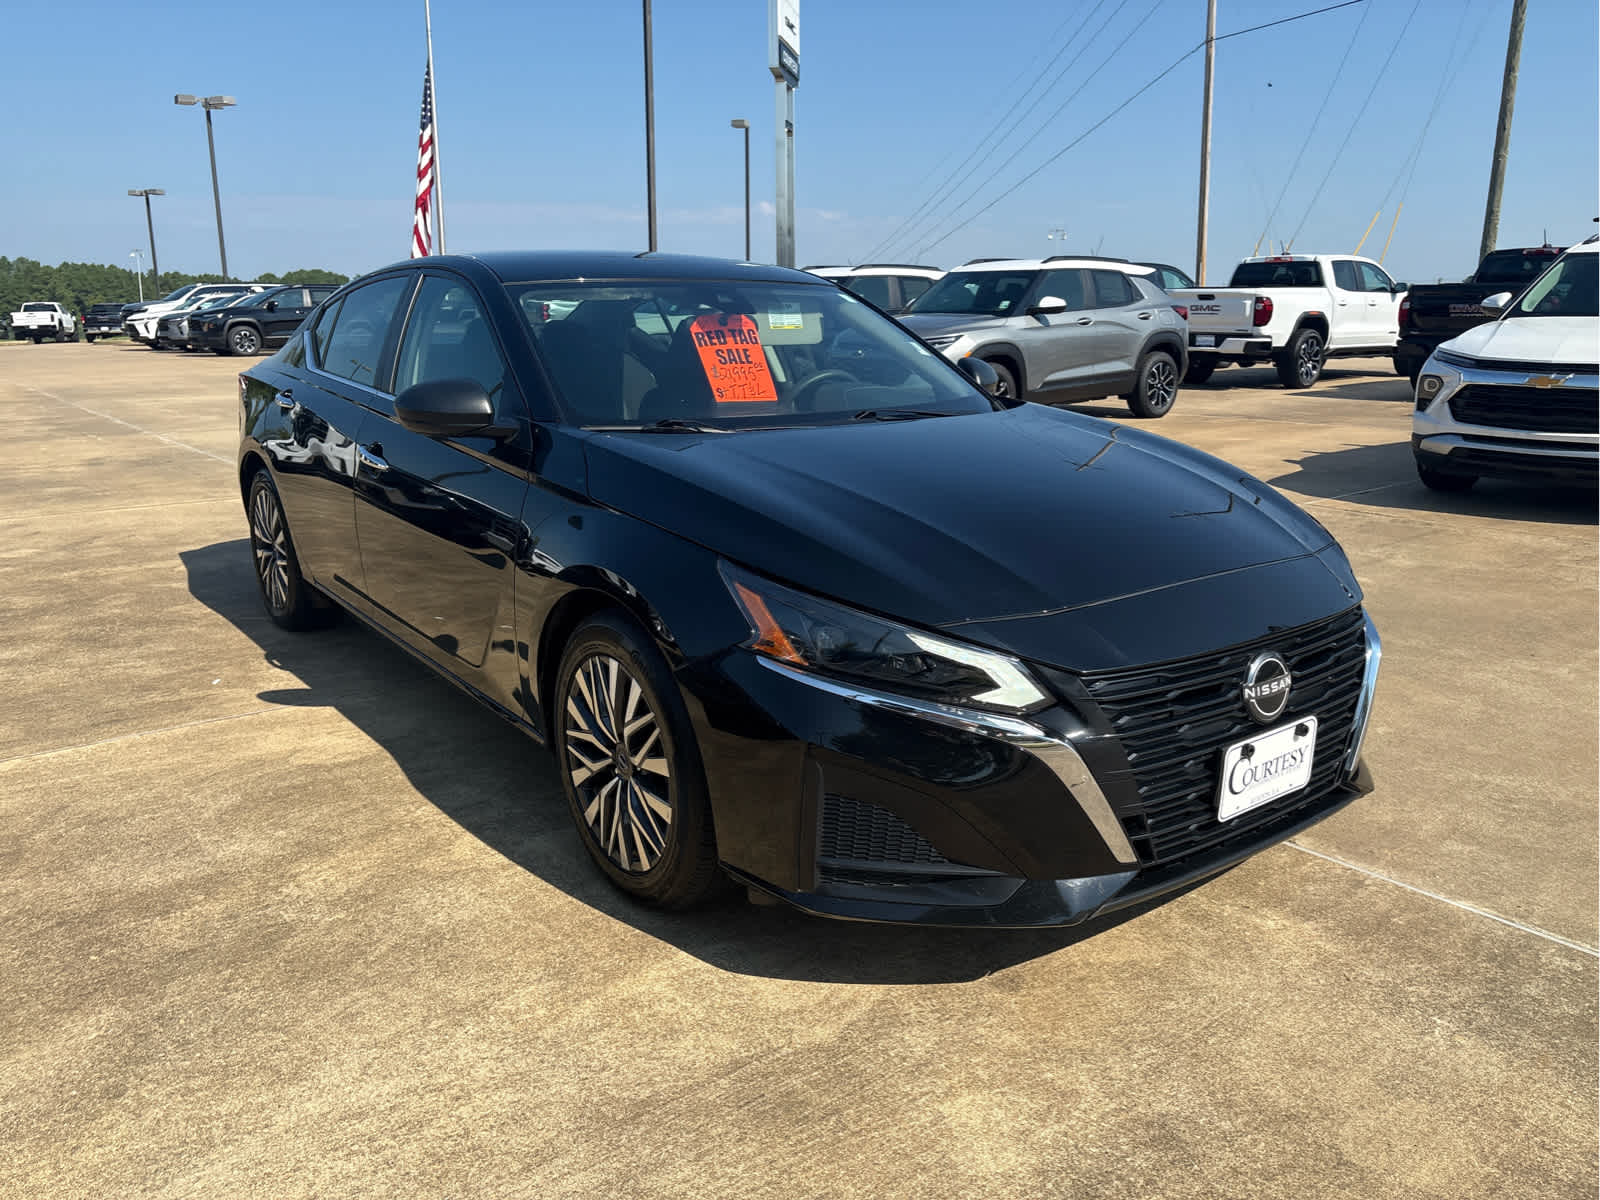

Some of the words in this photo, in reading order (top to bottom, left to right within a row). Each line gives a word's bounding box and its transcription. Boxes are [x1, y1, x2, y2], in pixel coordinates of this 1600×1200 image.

[694, 329, 728, 347] RED
[728, 328, 759, 345] TAG
[715, 348, 753, 365] SALE
[1244, 675, 1292, 700] NISSAN
[1228, 744, 1310, 796] COURTESY
